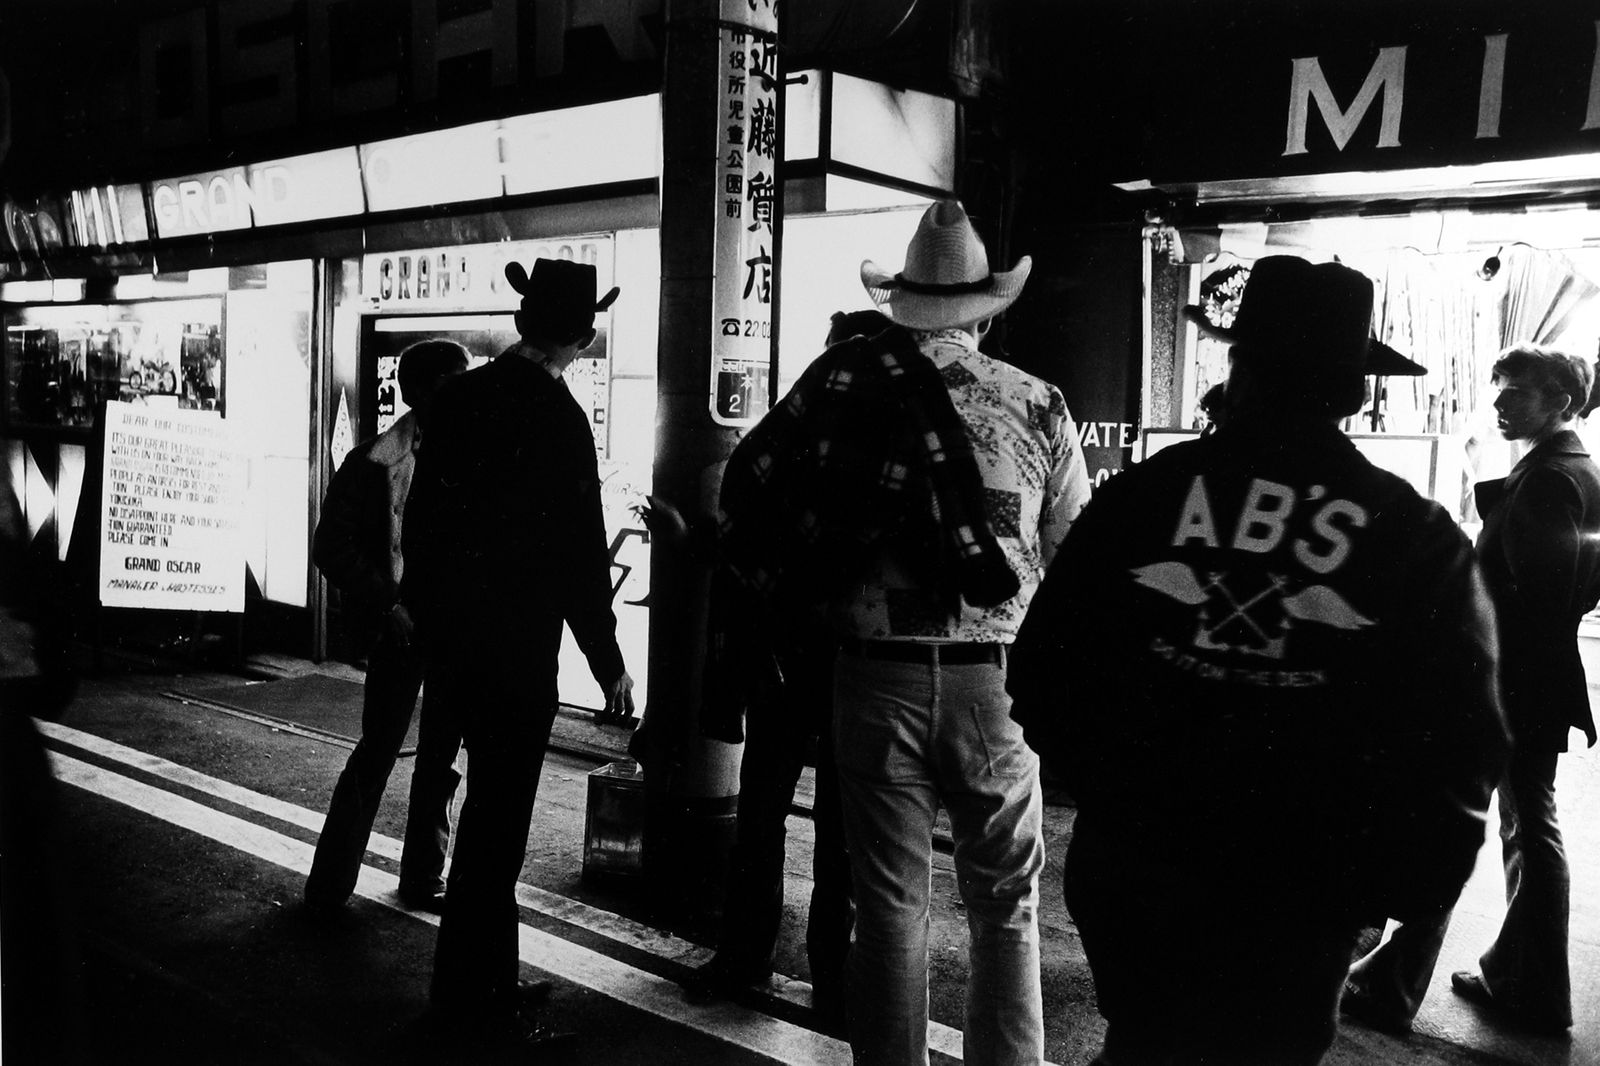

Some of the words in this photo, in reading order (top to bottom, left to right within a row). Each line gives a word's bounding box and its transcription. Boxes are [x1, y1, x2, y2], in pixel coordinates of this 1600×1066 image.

[153, 165, 293, 232] GRAND
[728, 394, 741, 413] 2
[122, 413, 149, 427] DEAR
[109, 506, 118, 518] NO
[120, 507, 158, 522] DISAPPOINT
[161, 512, 177, 524] HERE
[180, 515, 195, 527] AND
[1171, 474, 1368, 574] AB'S
[107, 531, 134, 545] PLEASE
[139, 534, 156, 547] COME
[160, 536, 169, 548] IN
[124, 556, 161, 572] GRAND
[165, 560, 201, 574] OSCAR
[106, 579, 158, 591] MANAGER
